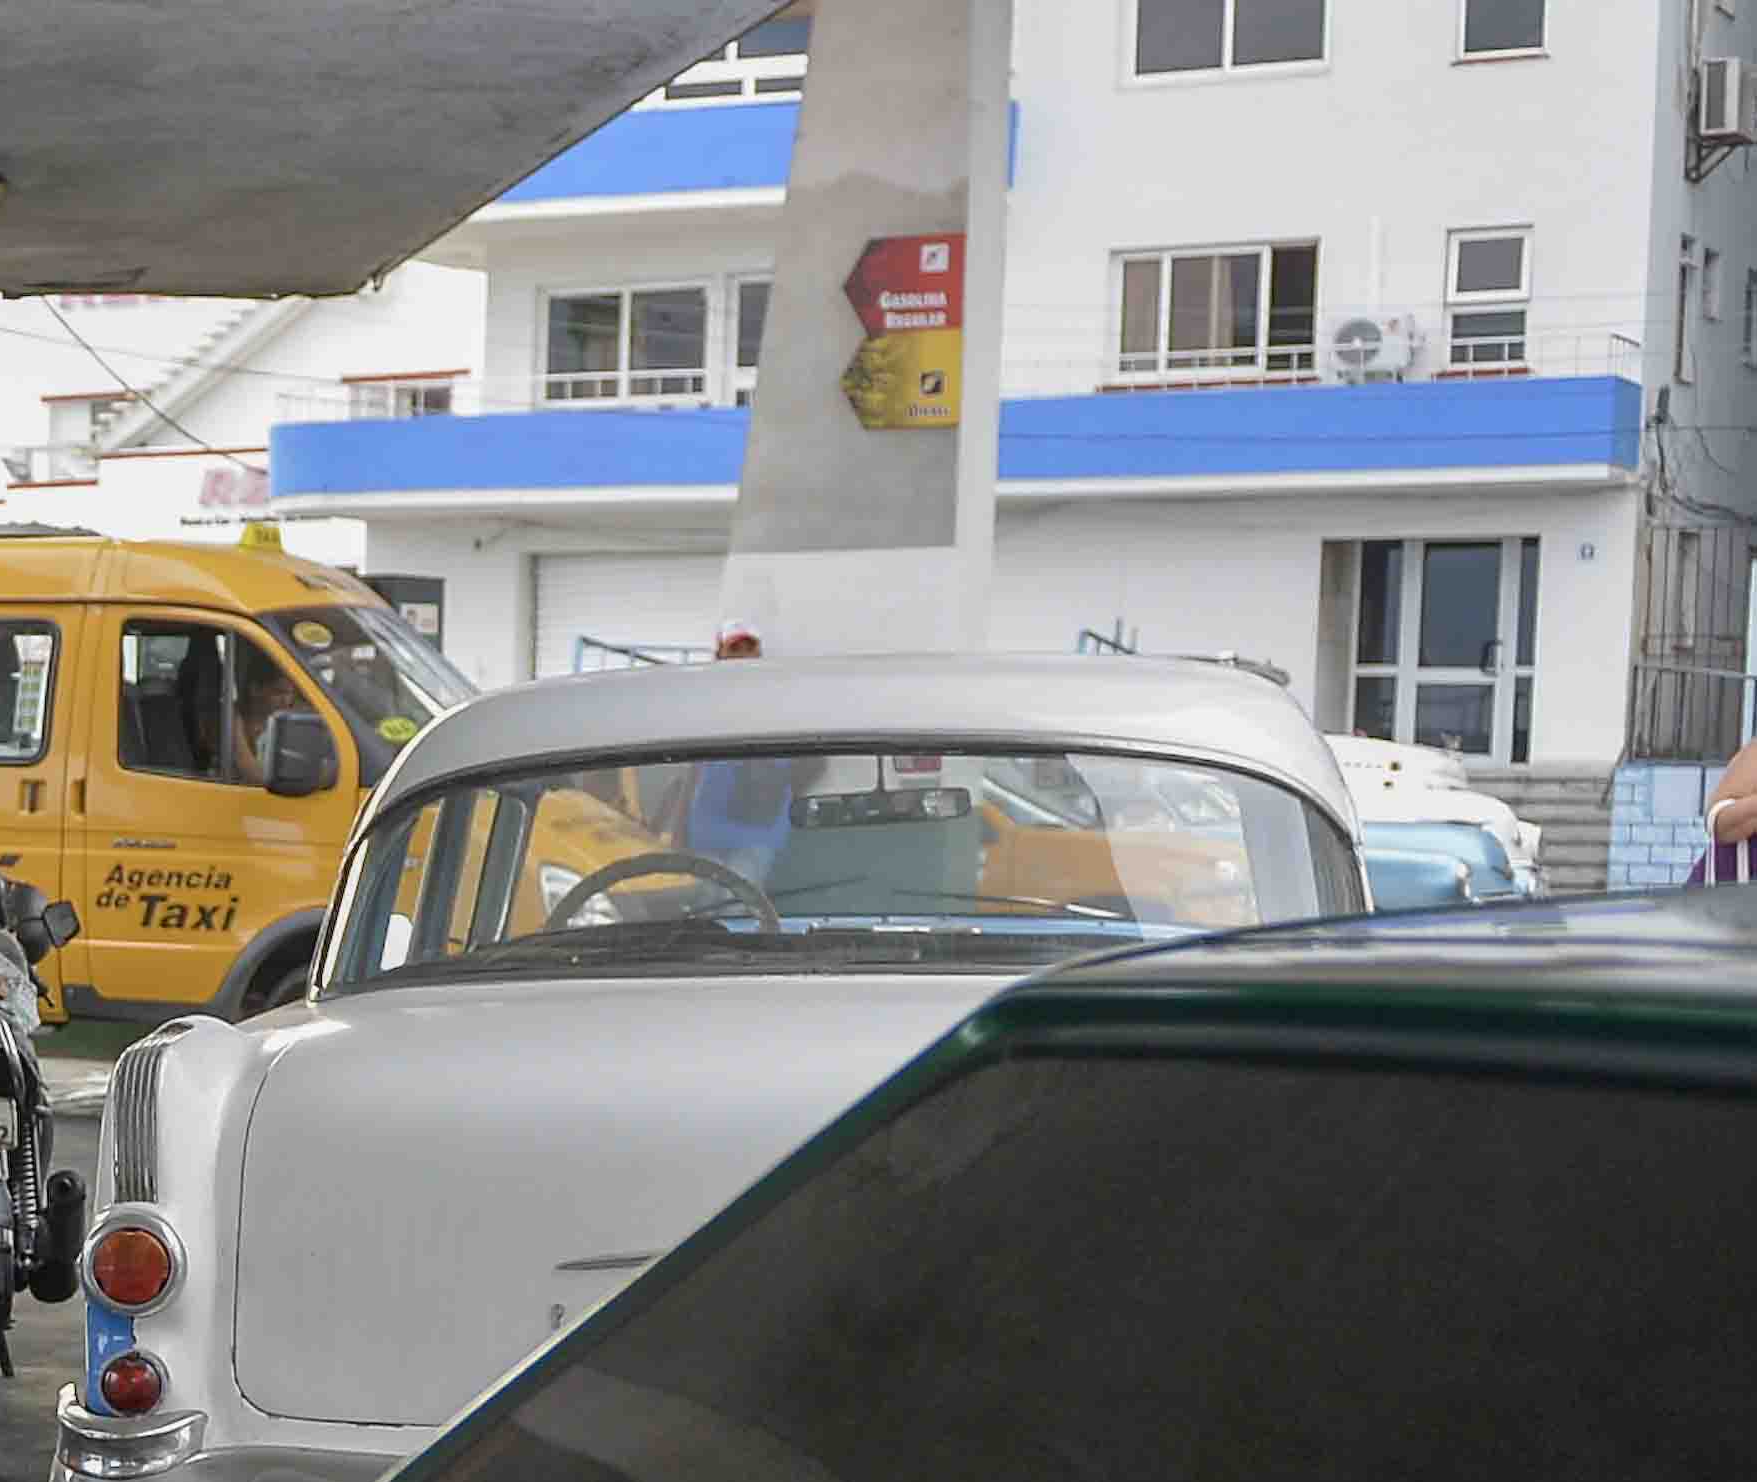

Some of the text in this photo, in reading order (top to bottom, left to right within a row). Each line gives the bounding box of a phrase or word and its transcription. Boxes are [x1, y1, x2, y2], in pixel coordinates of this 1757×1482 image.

[105, 863, 233, 890] Agencia
[95, 887, 239, 930] de Taxi
